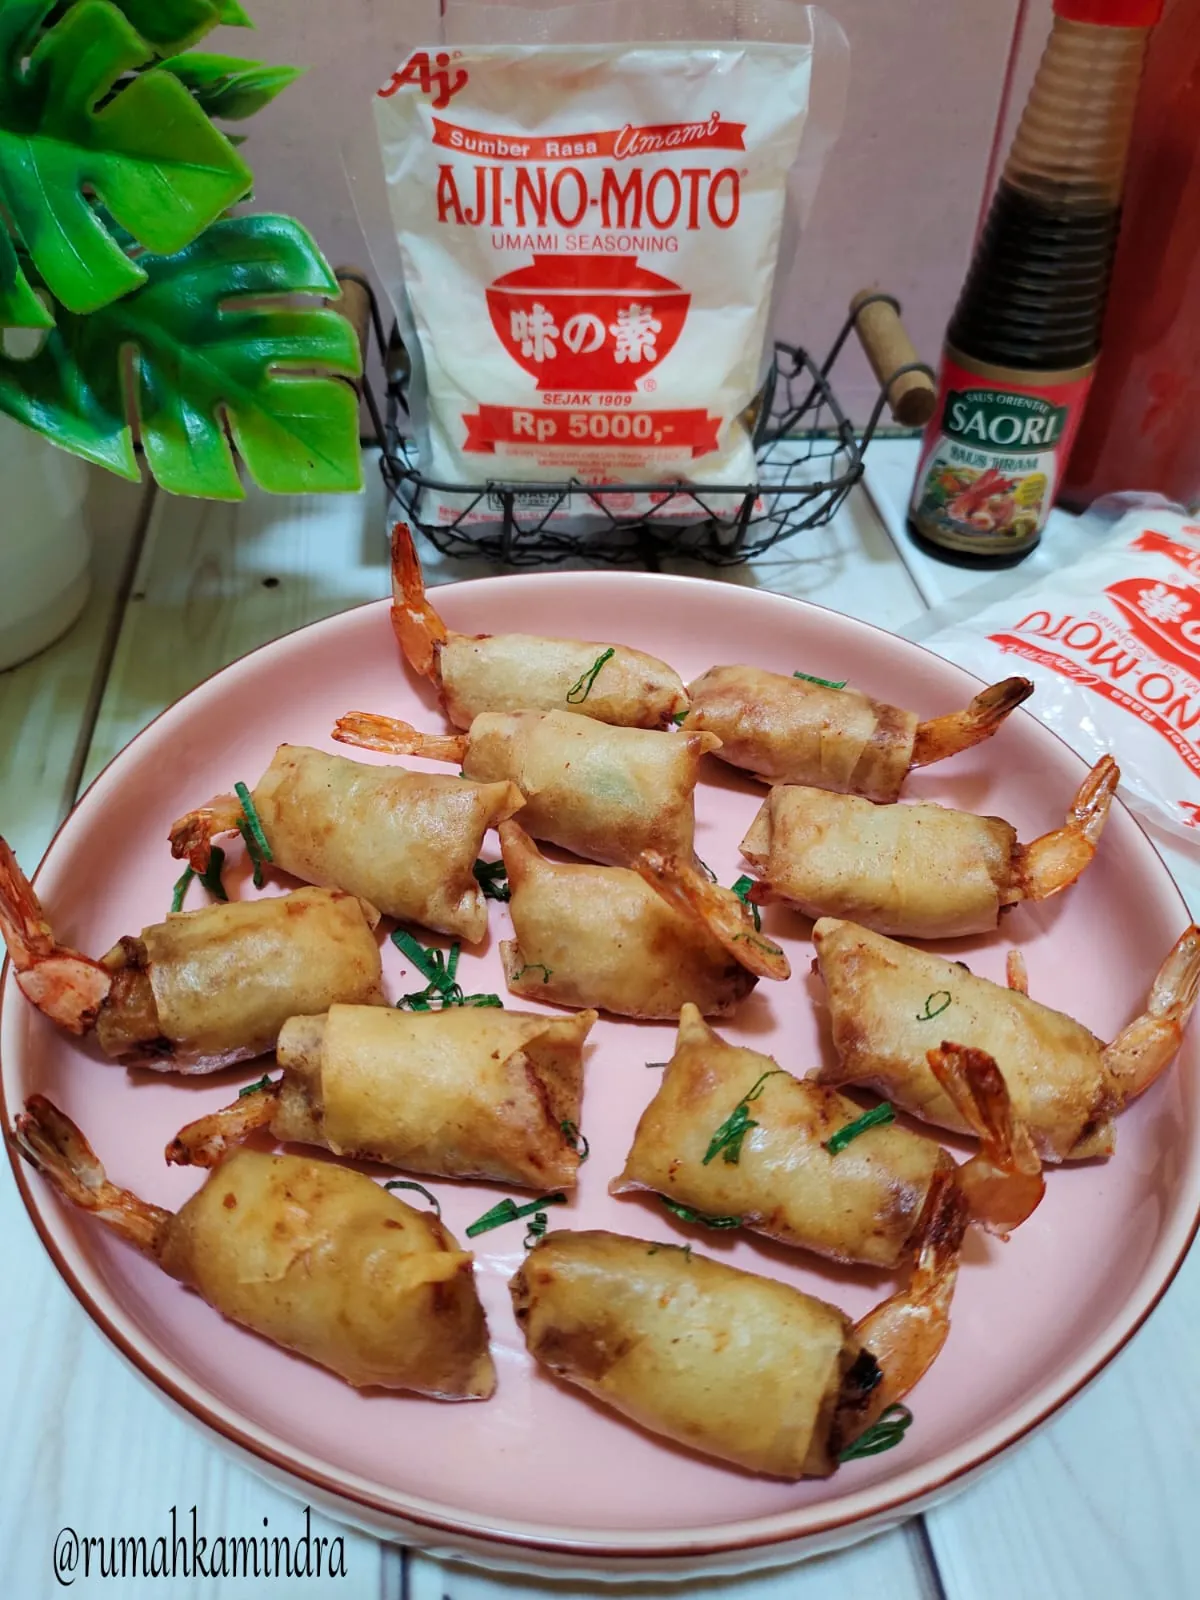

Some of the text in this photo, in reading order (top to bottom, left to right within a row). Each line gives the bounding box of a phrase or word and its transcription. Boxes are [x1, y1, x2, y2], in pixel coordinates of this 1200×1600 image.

[450, 111, 721, 161] Sumber Rasa Umami
[436, 163, 741, 231] AJI-NO-MOTO
[491, 234, 679, 253] UMAMI SEASONING
[509, 302, 662, 364] 味の素
[542, 393, 633, 407] SEJAK 1909
[511, 411, 675, 444] Rp 5000,-
[949, 402, 1058, 445] SAORI
[1012, 609, 1200, 733] NO-MOTO
[1110, 689, 1157, 723] Rasa
